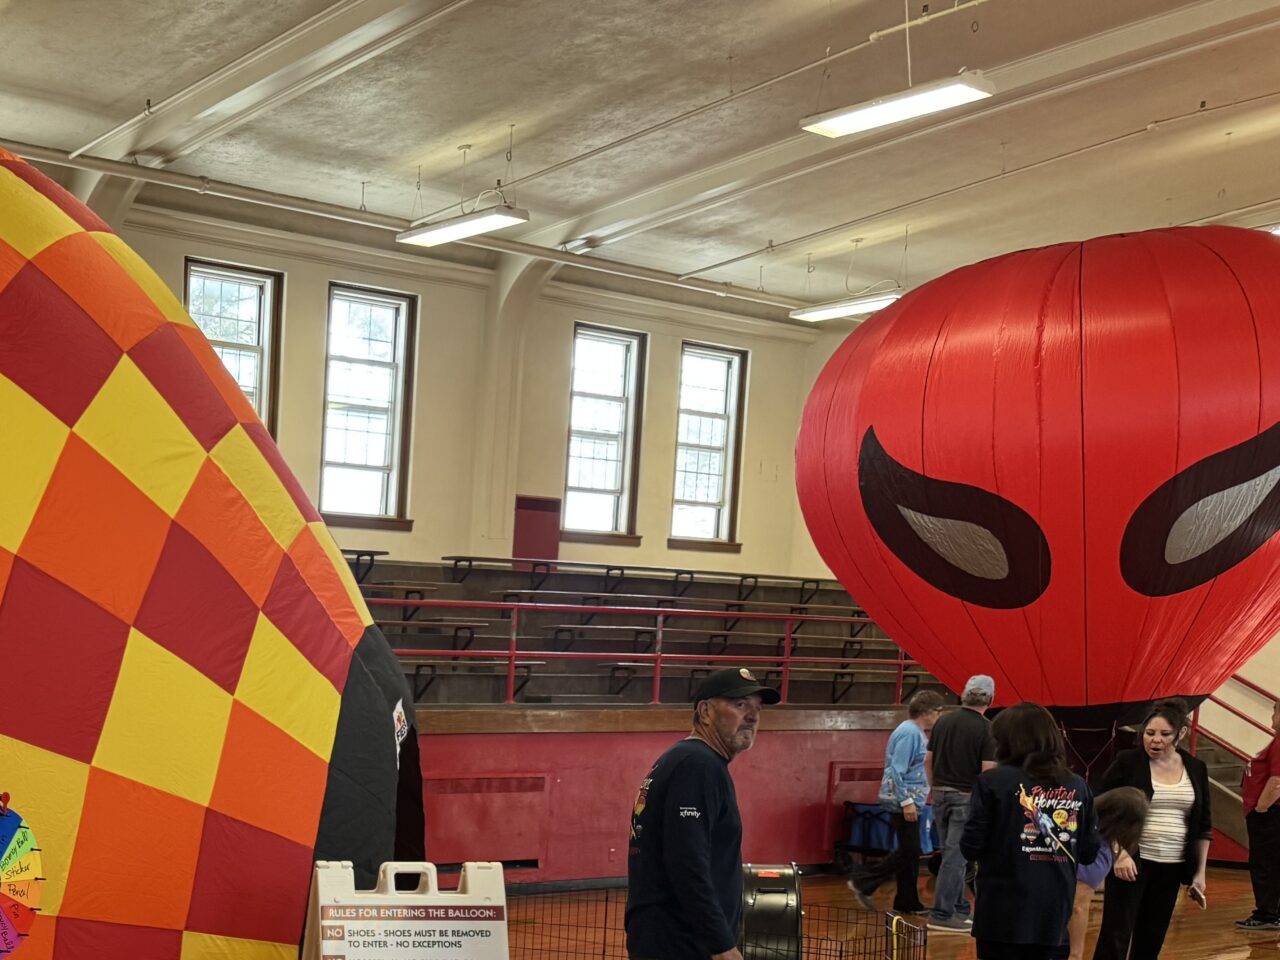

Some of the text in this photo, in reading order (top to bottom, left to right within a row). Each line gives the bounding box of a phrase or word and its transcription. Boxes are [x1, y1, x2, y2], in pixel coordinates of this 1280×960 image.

[1032, 785, 1076, 800] Painted
[680, 810, 701, 818] xfinity
[5, 861, 30, 880] Sticker
[329, 909, 496, 918] RULES FOR ENTERING THE BALLOON:
[327, 929, 342, 937] NO
[348, 929, 376, 938] SHOES
[384, 929, 412, 938] SHOES
[414, 929, 436, 938] MUST
[439, 929, 449, 938] BE
[451, 929, 491, 938] REMOVED
[348, 940, 360, 949] TO
[362, 940, 388, 949] ENTER
[396, 940, 410, 949] NO
[412, 940, 462, 949] EXCEPTIONS
